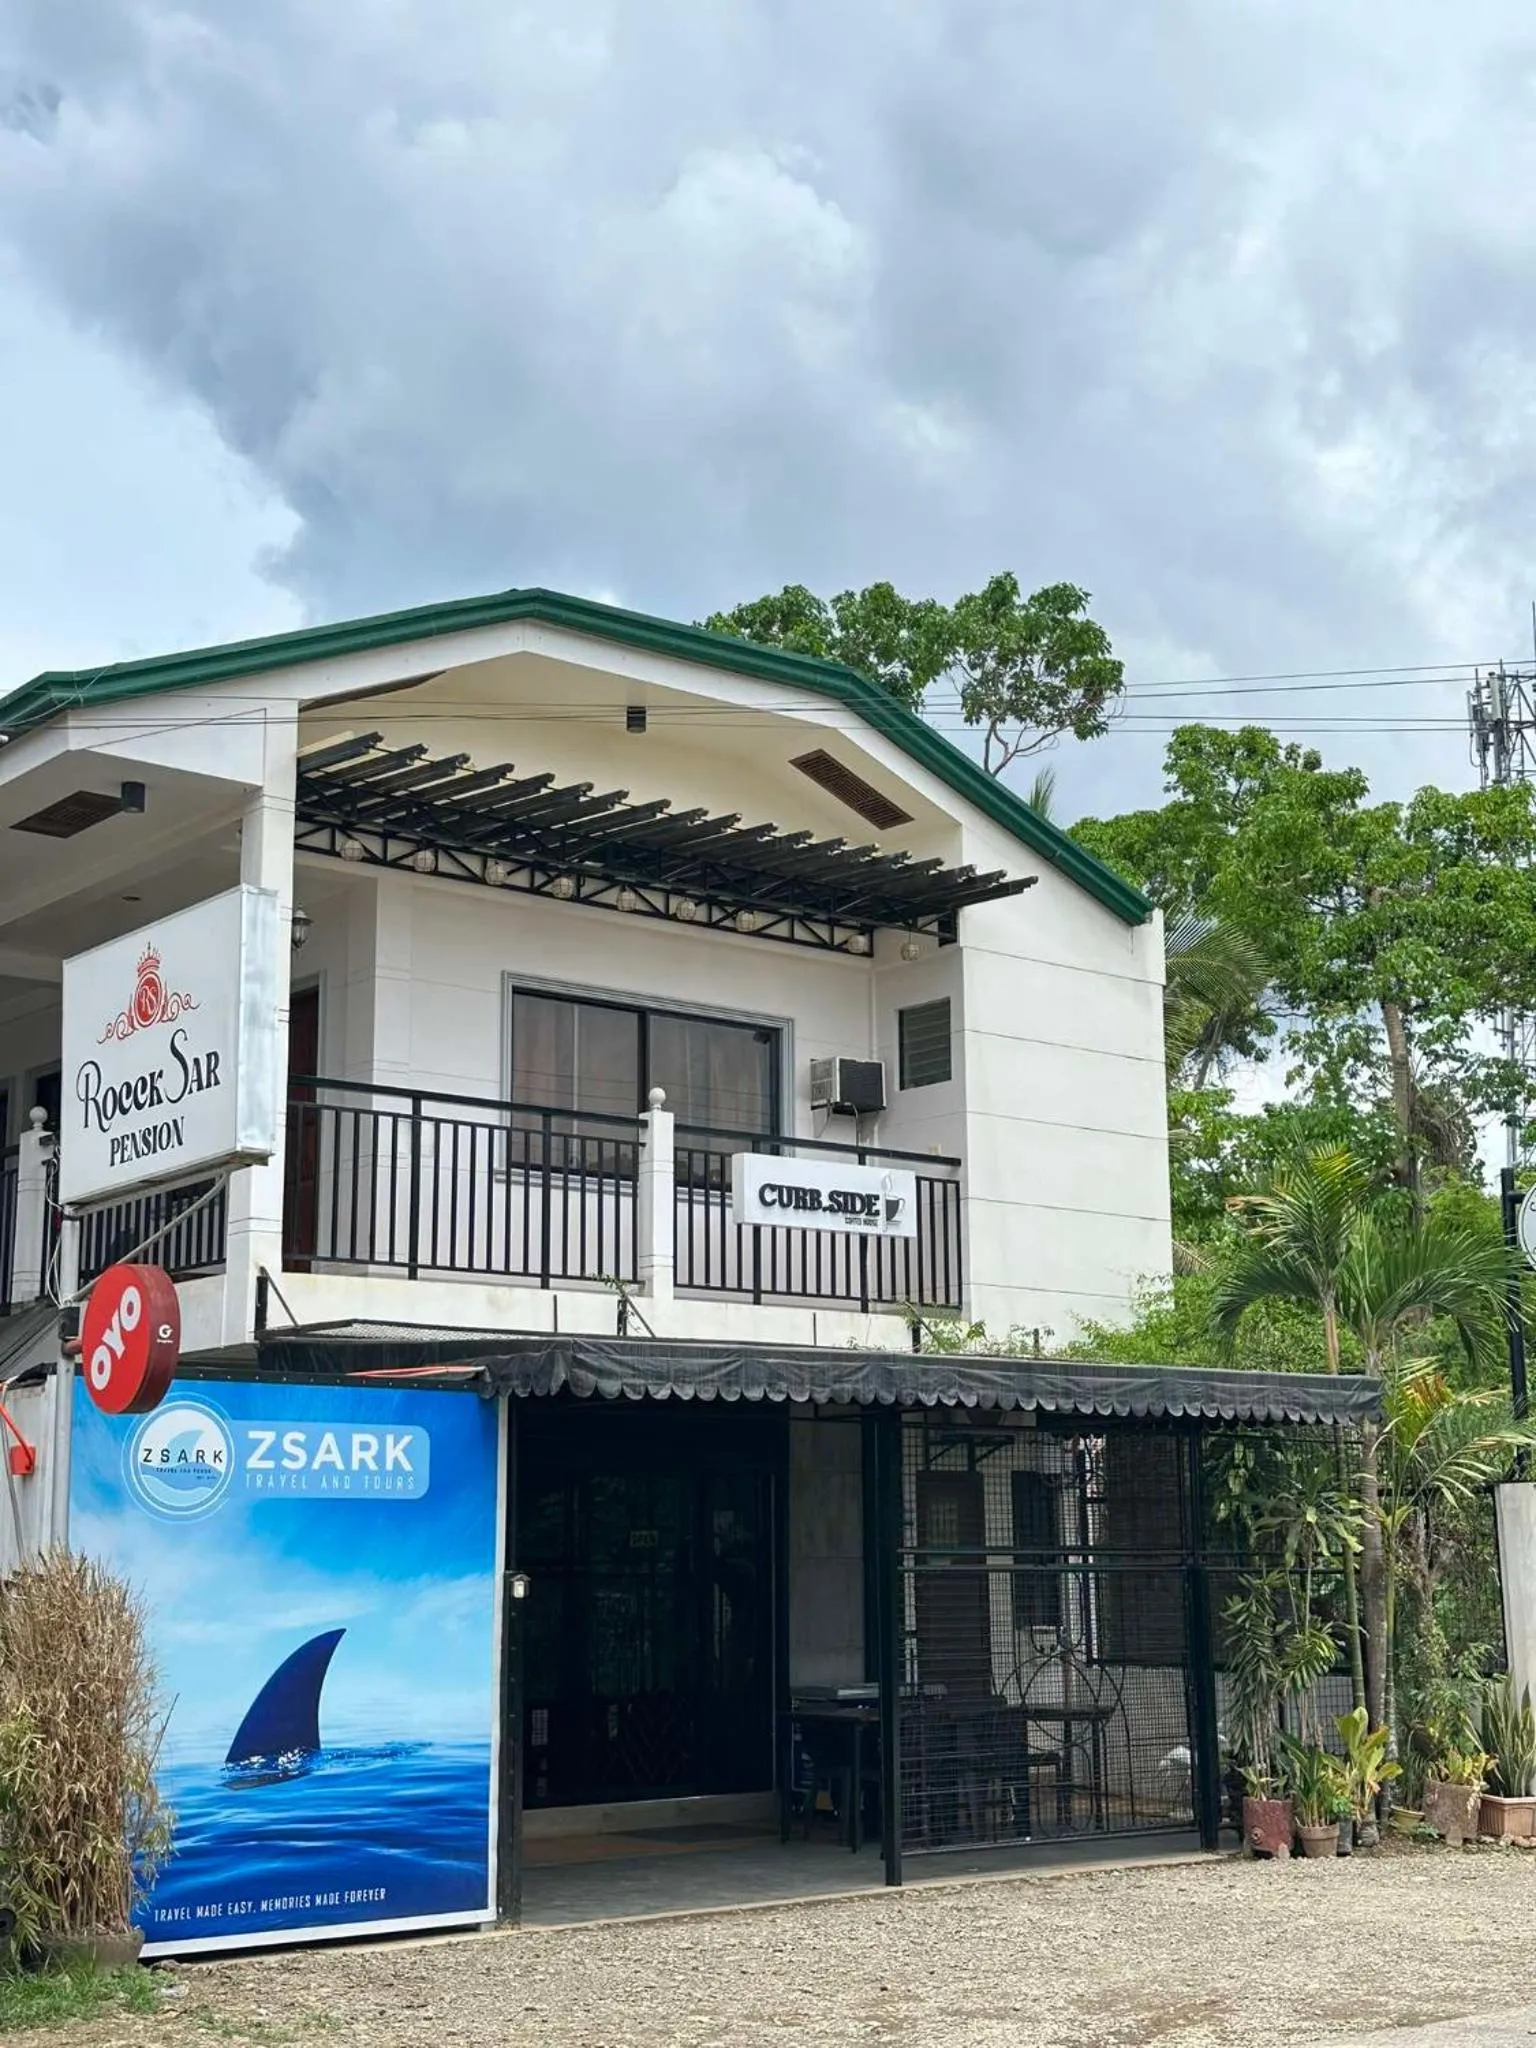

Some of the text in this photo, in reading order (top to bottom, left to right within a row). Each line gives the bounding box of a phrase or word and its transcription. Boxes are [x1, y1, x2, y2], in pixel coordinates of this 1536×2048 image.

[109, 1116, 185, 1167] PENSION
[91, 1286, 141, 1391] OYO
[142, 1448, 223, 1464] ZSARK
[246, 1430, 414, 1472] ZSARK
[245, 1473, 415, 1491] TRAVEL AND TOURS
[154, 1906, 192, 1922] TRAVEL
[196, 1903, 223, 1918] MADE
[260, 1894, 311, 1912] MEMORIES
[315, 1891, 340, 1907] MADE
[344, 1887, 386, 1903] FOREVER
